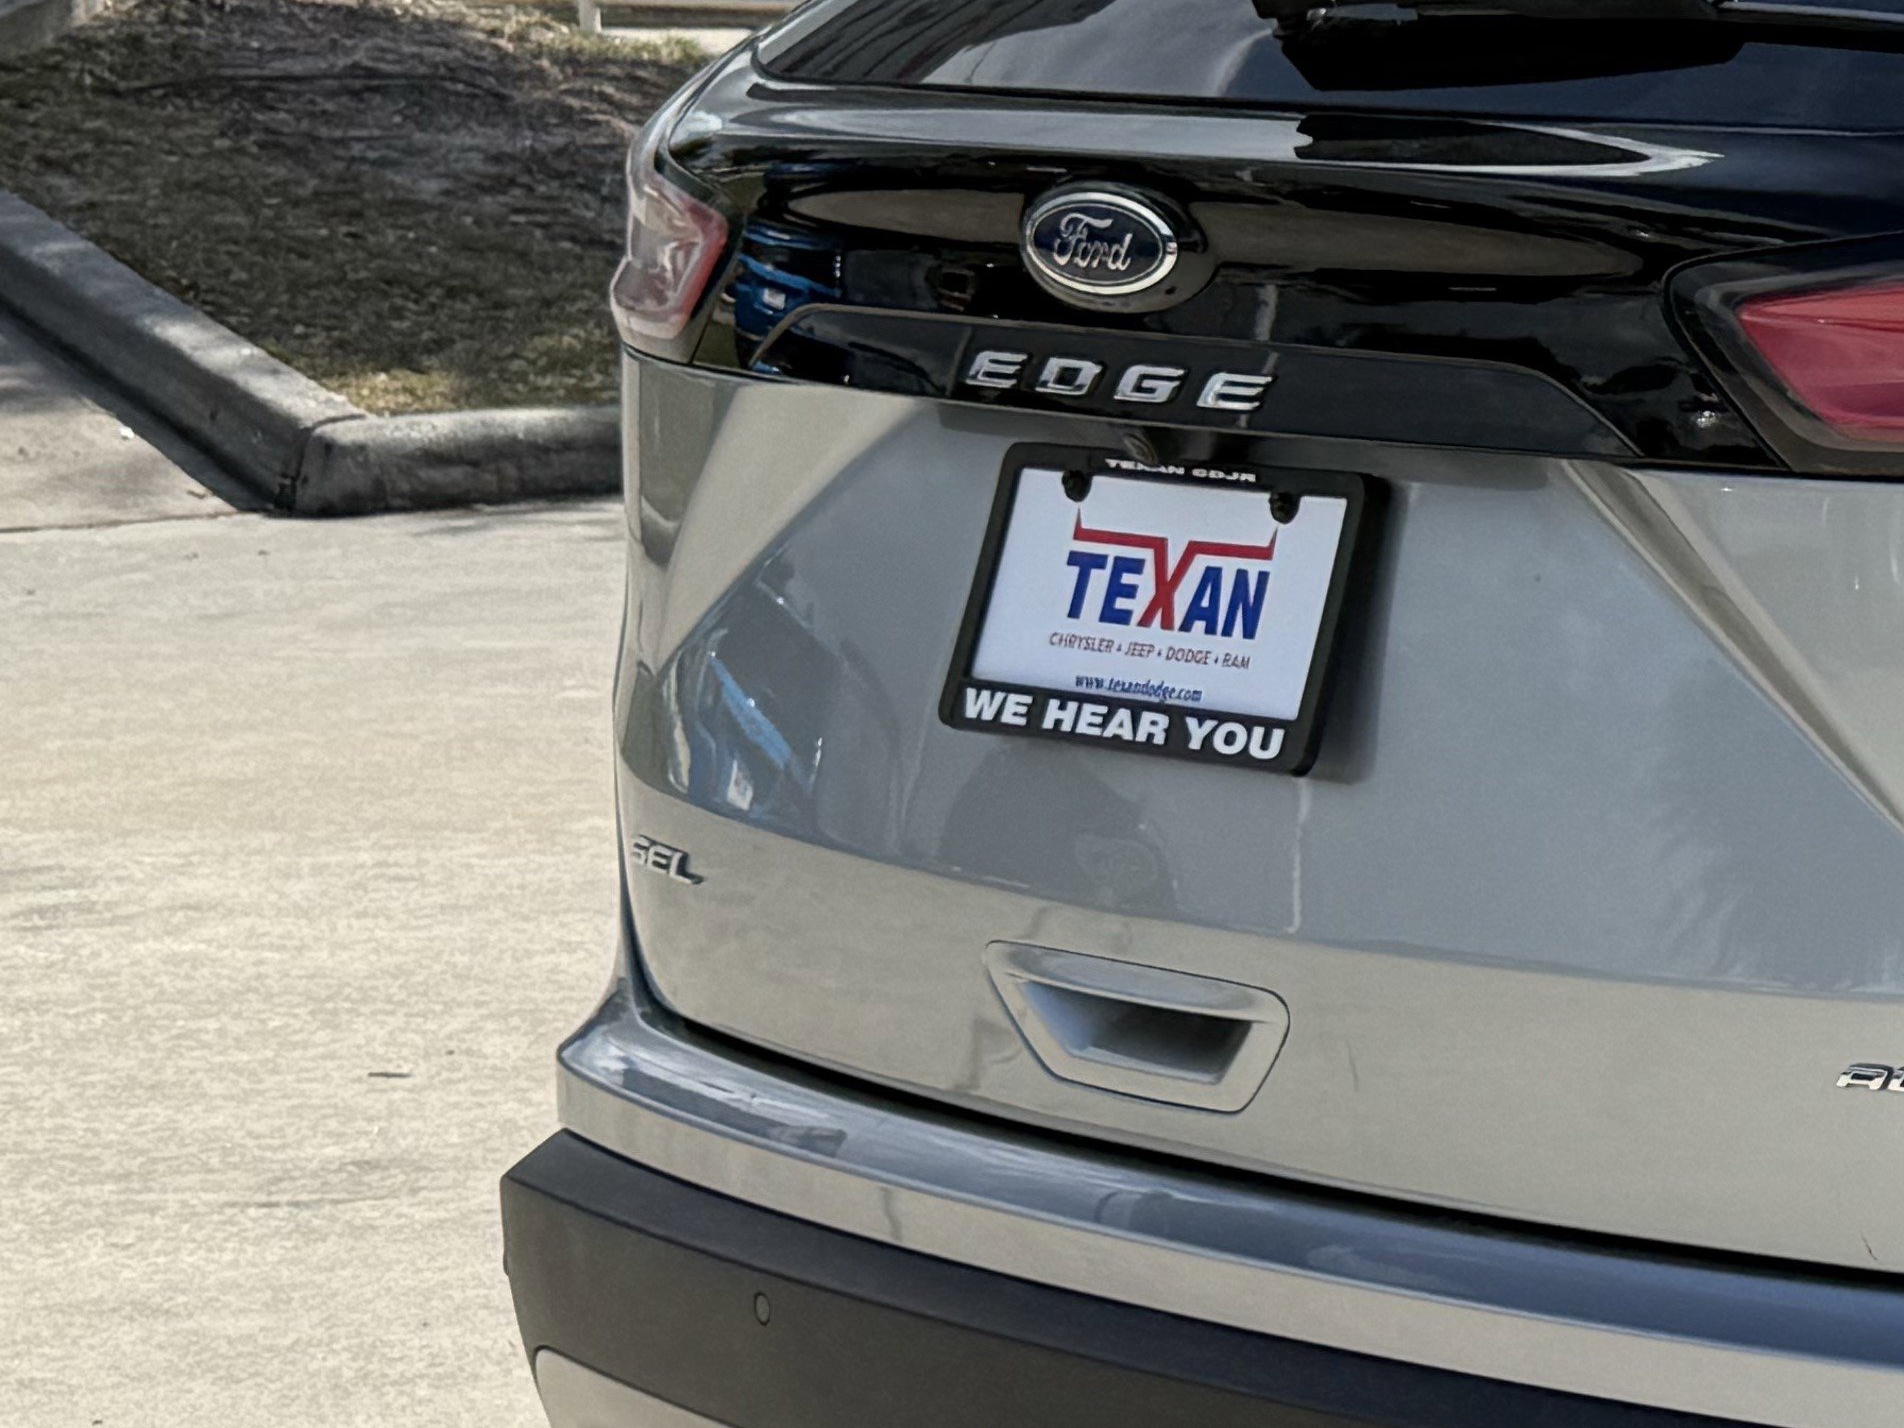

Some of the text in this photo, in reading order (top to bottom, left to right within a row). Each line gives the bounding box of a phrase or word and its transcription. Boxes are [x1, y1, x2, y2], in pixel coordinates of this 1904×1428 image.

[1052, 212, 1131, 274] Ford
[964, 350, 1275, 411] EDGE
[1066, 534, 1272, 640] TEXAN
[1049, 632, 1251, 670] CHRYSLER JEEP DODGE RAM
[963, 688, 1286, 761] WE HEAR YOU
